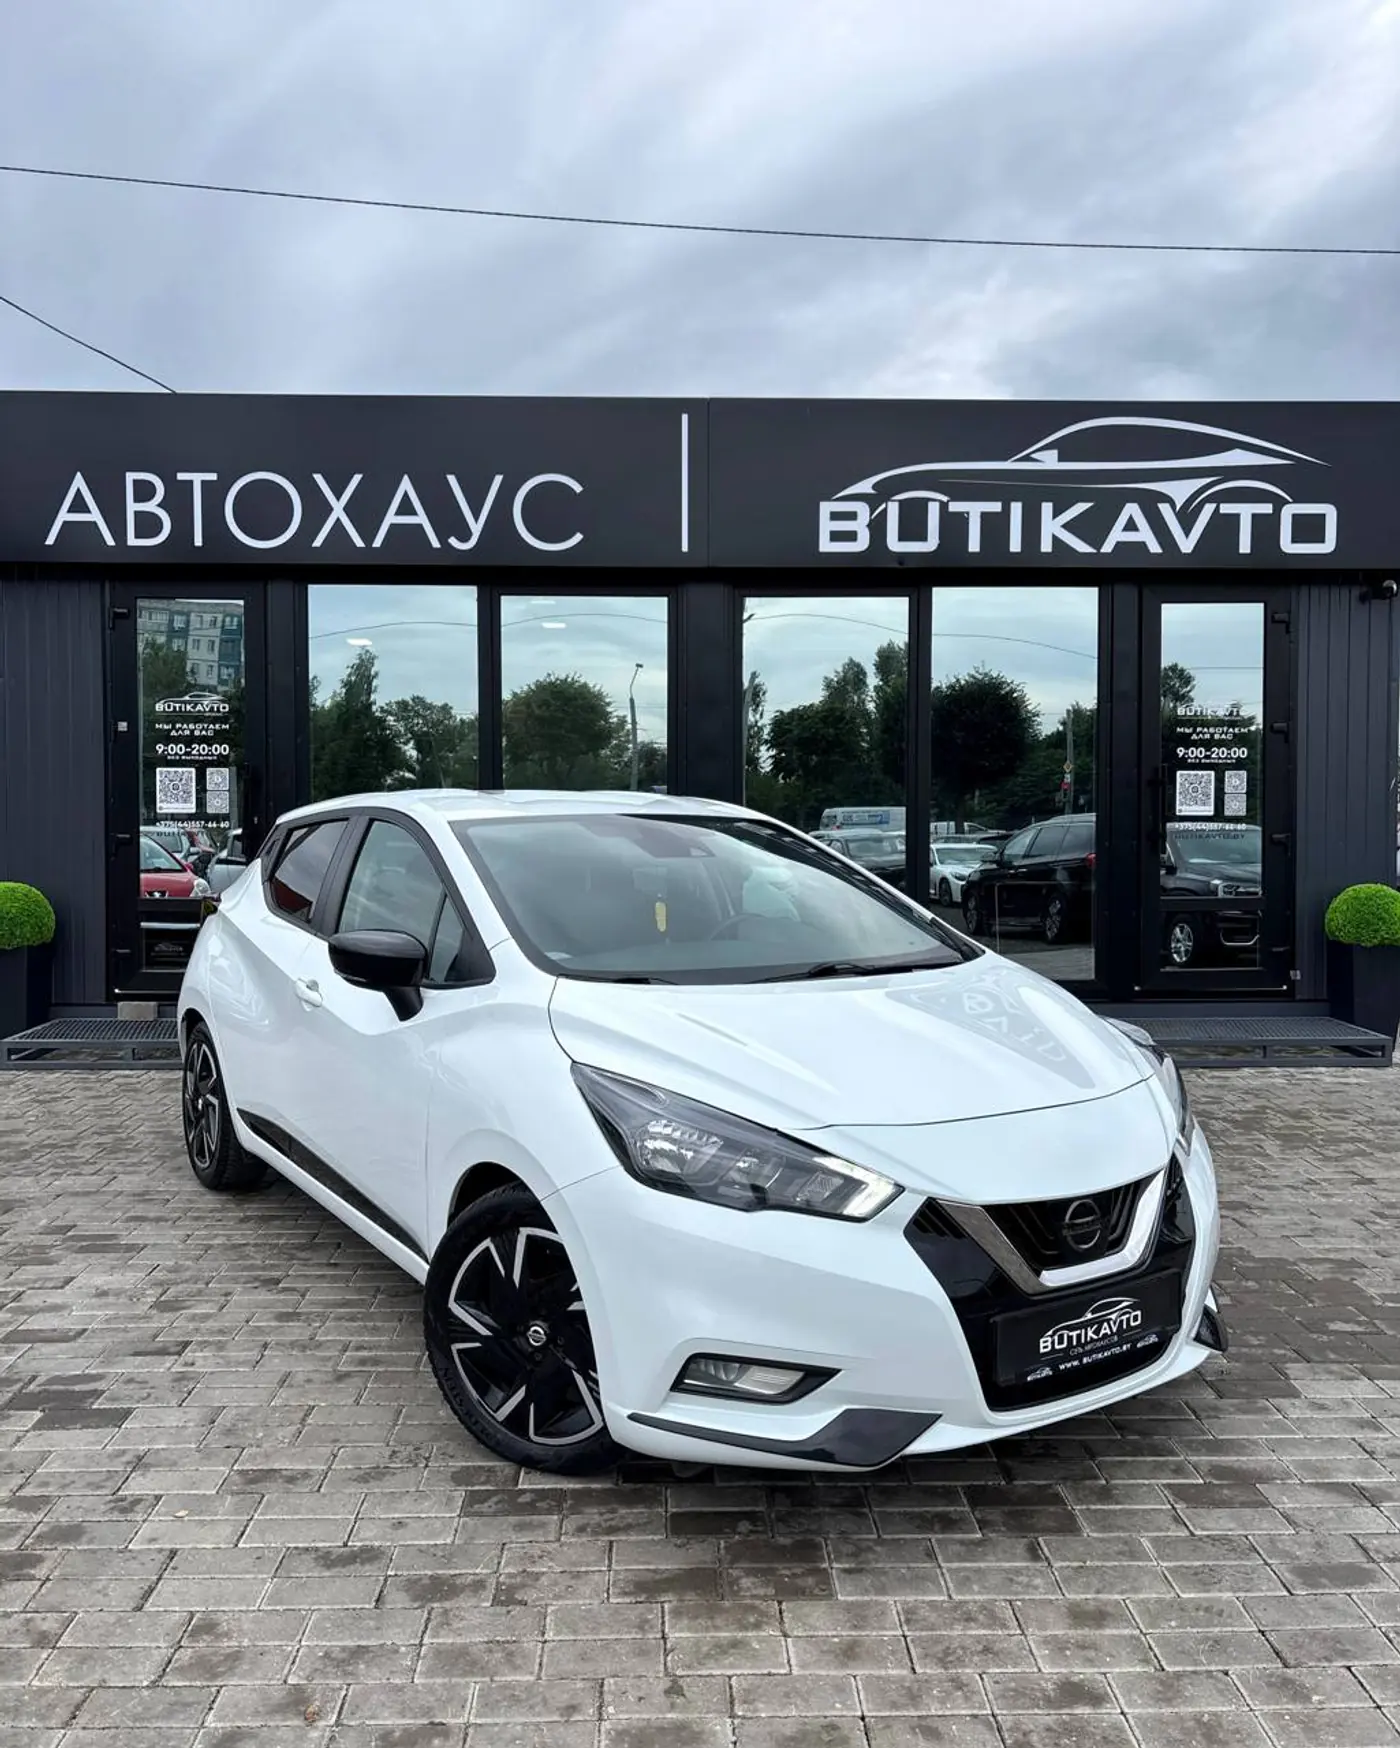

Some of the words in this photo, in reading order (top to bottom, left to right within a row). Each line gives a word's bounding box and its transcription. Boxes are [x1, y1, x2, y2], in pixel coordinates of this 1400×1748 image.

[44, 471, 585, 551] АВТОХАУС
[818, 500, 1338, 554] BUTIKAVTO
[155, 703, 229, 712] BUTIKAVTO
[155, 743, 230, 755] 9:00-20:00
[1176, 747, 1248, 758] 9:00-20:00
[1039, 1310, 1142, 1353] BUTIKAVTO
